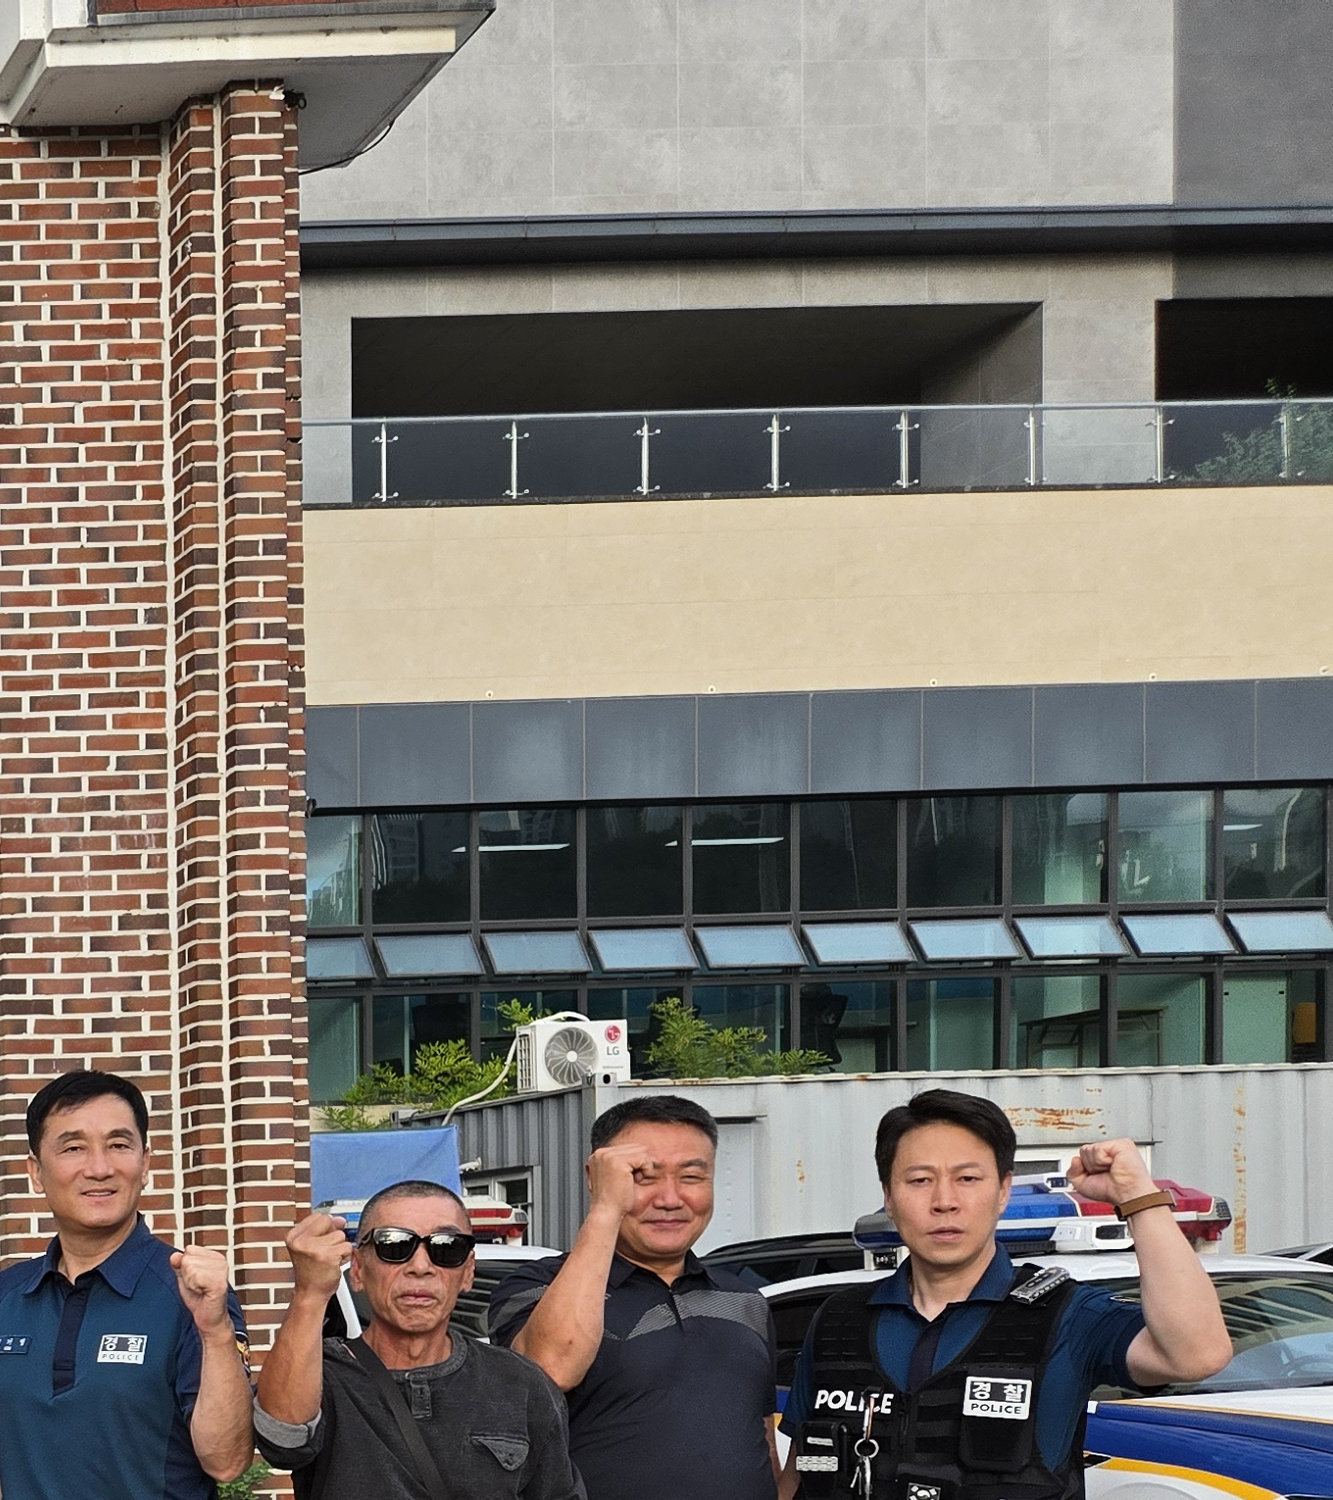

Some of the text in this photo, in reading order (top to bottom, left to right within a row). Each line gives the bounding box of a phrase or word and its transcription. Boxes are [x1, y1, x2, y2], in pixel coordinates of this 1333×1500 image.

[607, 1046, 619, 1055] LG
[104, 1337, 143, 1351] 경찰
[102, 1352, 140, 1361] POLICE
[972, 1382, 1025, 1402] 경찰
[970, 1403, 1022, 1415] POLICE
